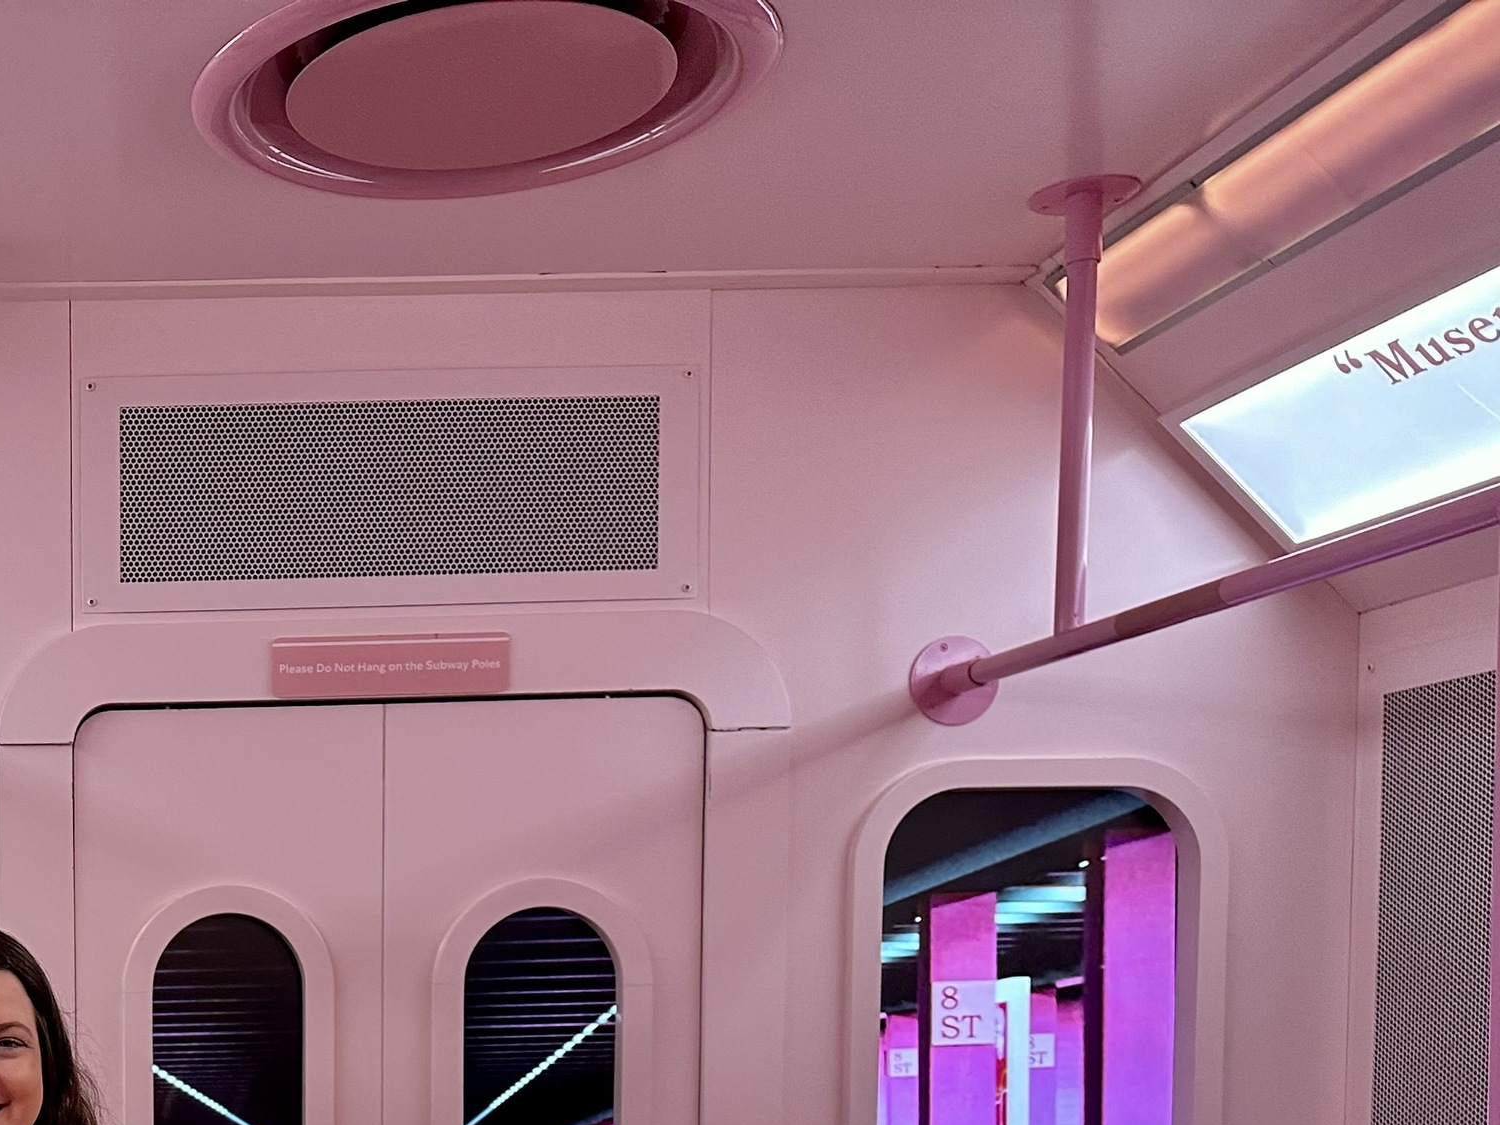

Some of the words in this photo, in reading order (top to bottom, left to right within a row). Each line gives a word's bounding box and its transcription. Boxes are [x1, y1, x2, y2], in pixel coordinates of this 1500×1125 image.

[1333, 306, 1500, 386] “Muse
[279, 663, 314, 674] Please
[316, 663, 332, 673] Do
[334, 662, 355, 672] Not
[358, 662, 387, 674] Hang
[388, 663, 403, 671] on
[405, 661, 424, 671] the
[426, 660, 469, 672] Subway
[471, 659, 501, 669] Poles
[941, 985, 959, 1010] 8
[941, 1014, 982, 1040] ST
[894, 1063, 913, 1074] ST
